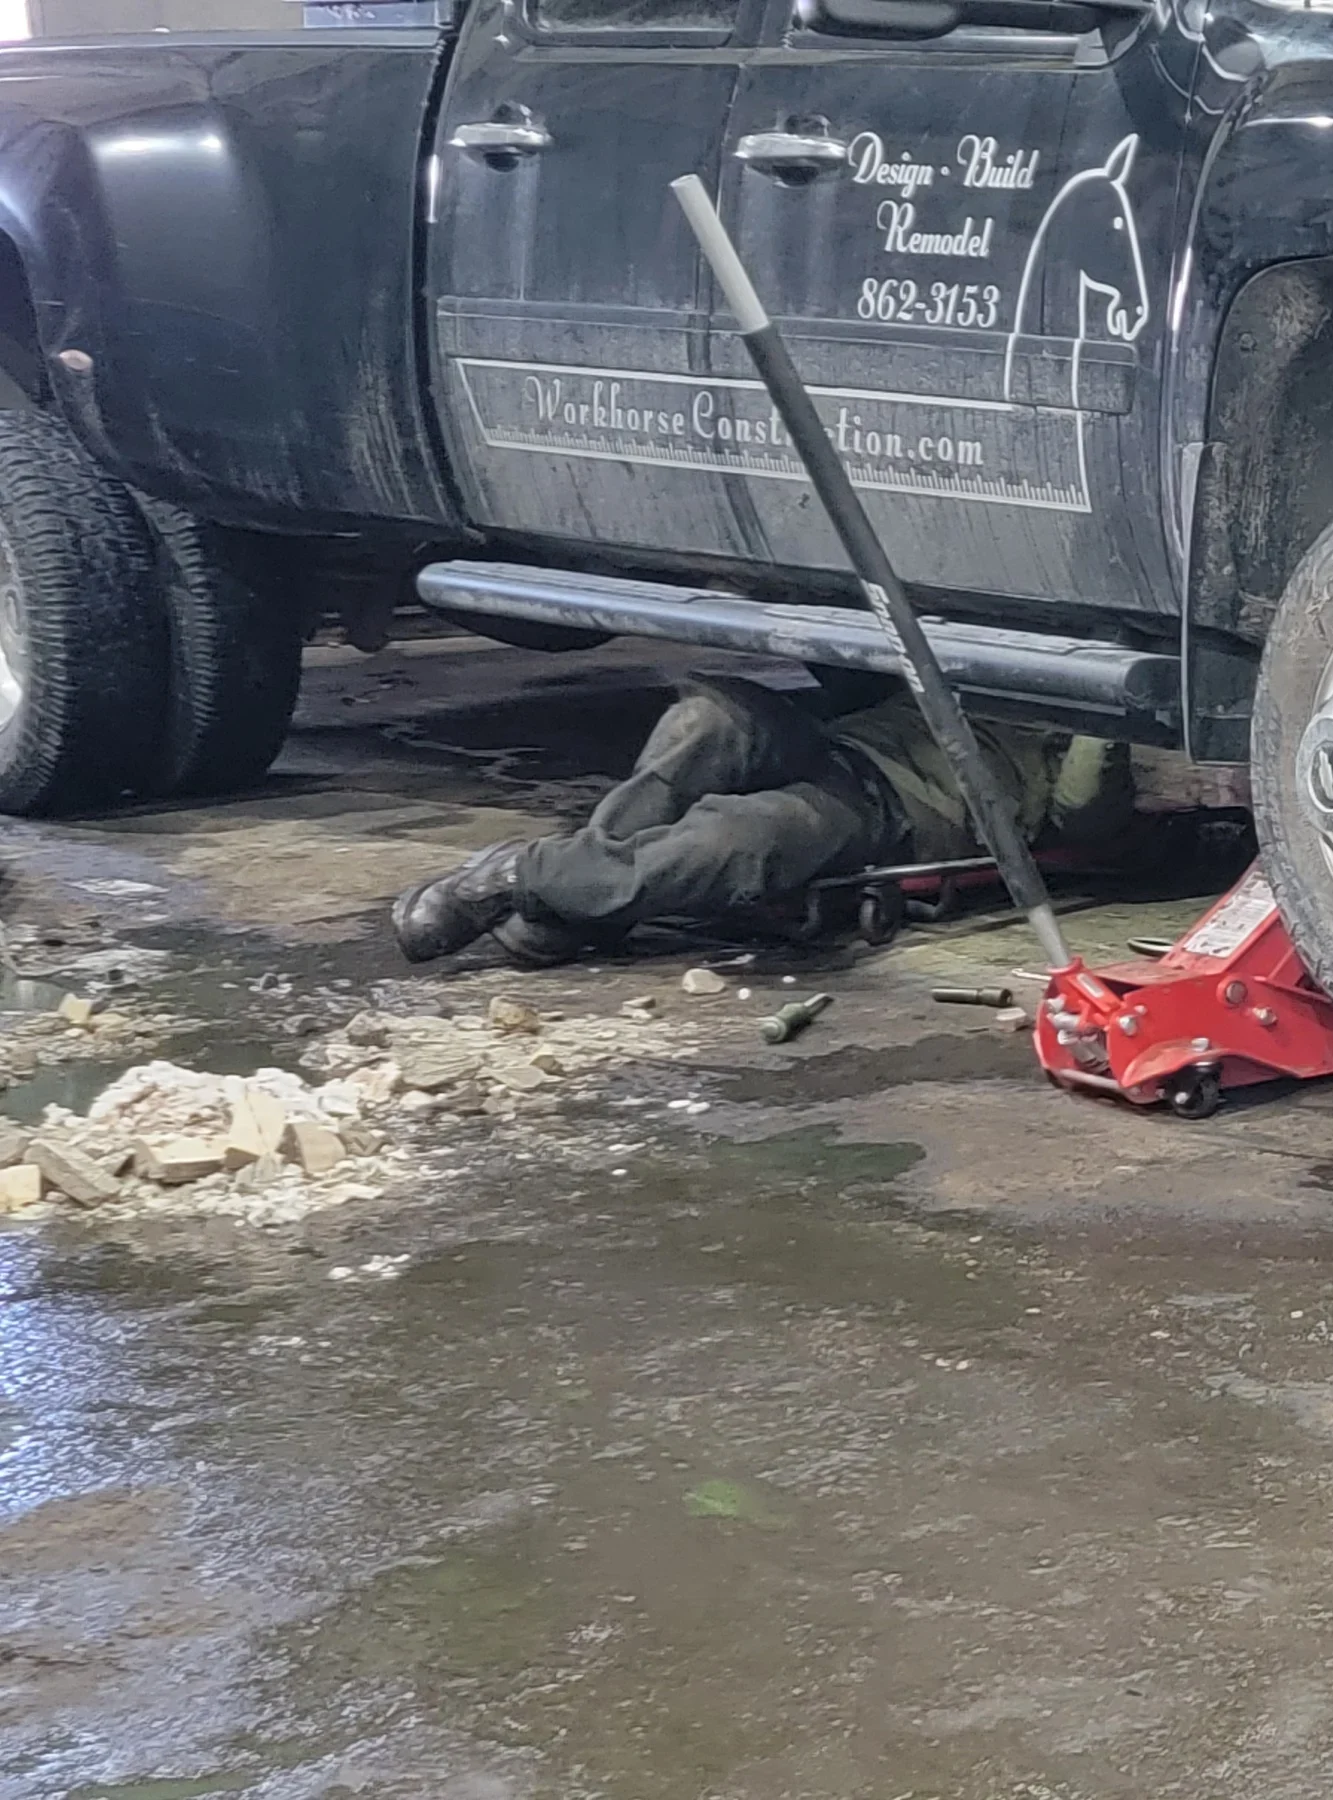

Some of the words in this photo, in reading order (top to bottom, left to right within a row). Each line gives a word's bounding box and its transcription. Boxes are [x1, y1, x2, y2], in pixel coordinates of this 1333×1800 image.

[847, 131, 935, 198] Design
[956, 134, 1040, 188] Build
[876, 200, 994, 257] Remodel
[857, 277, 1000, 328] 862-3153
